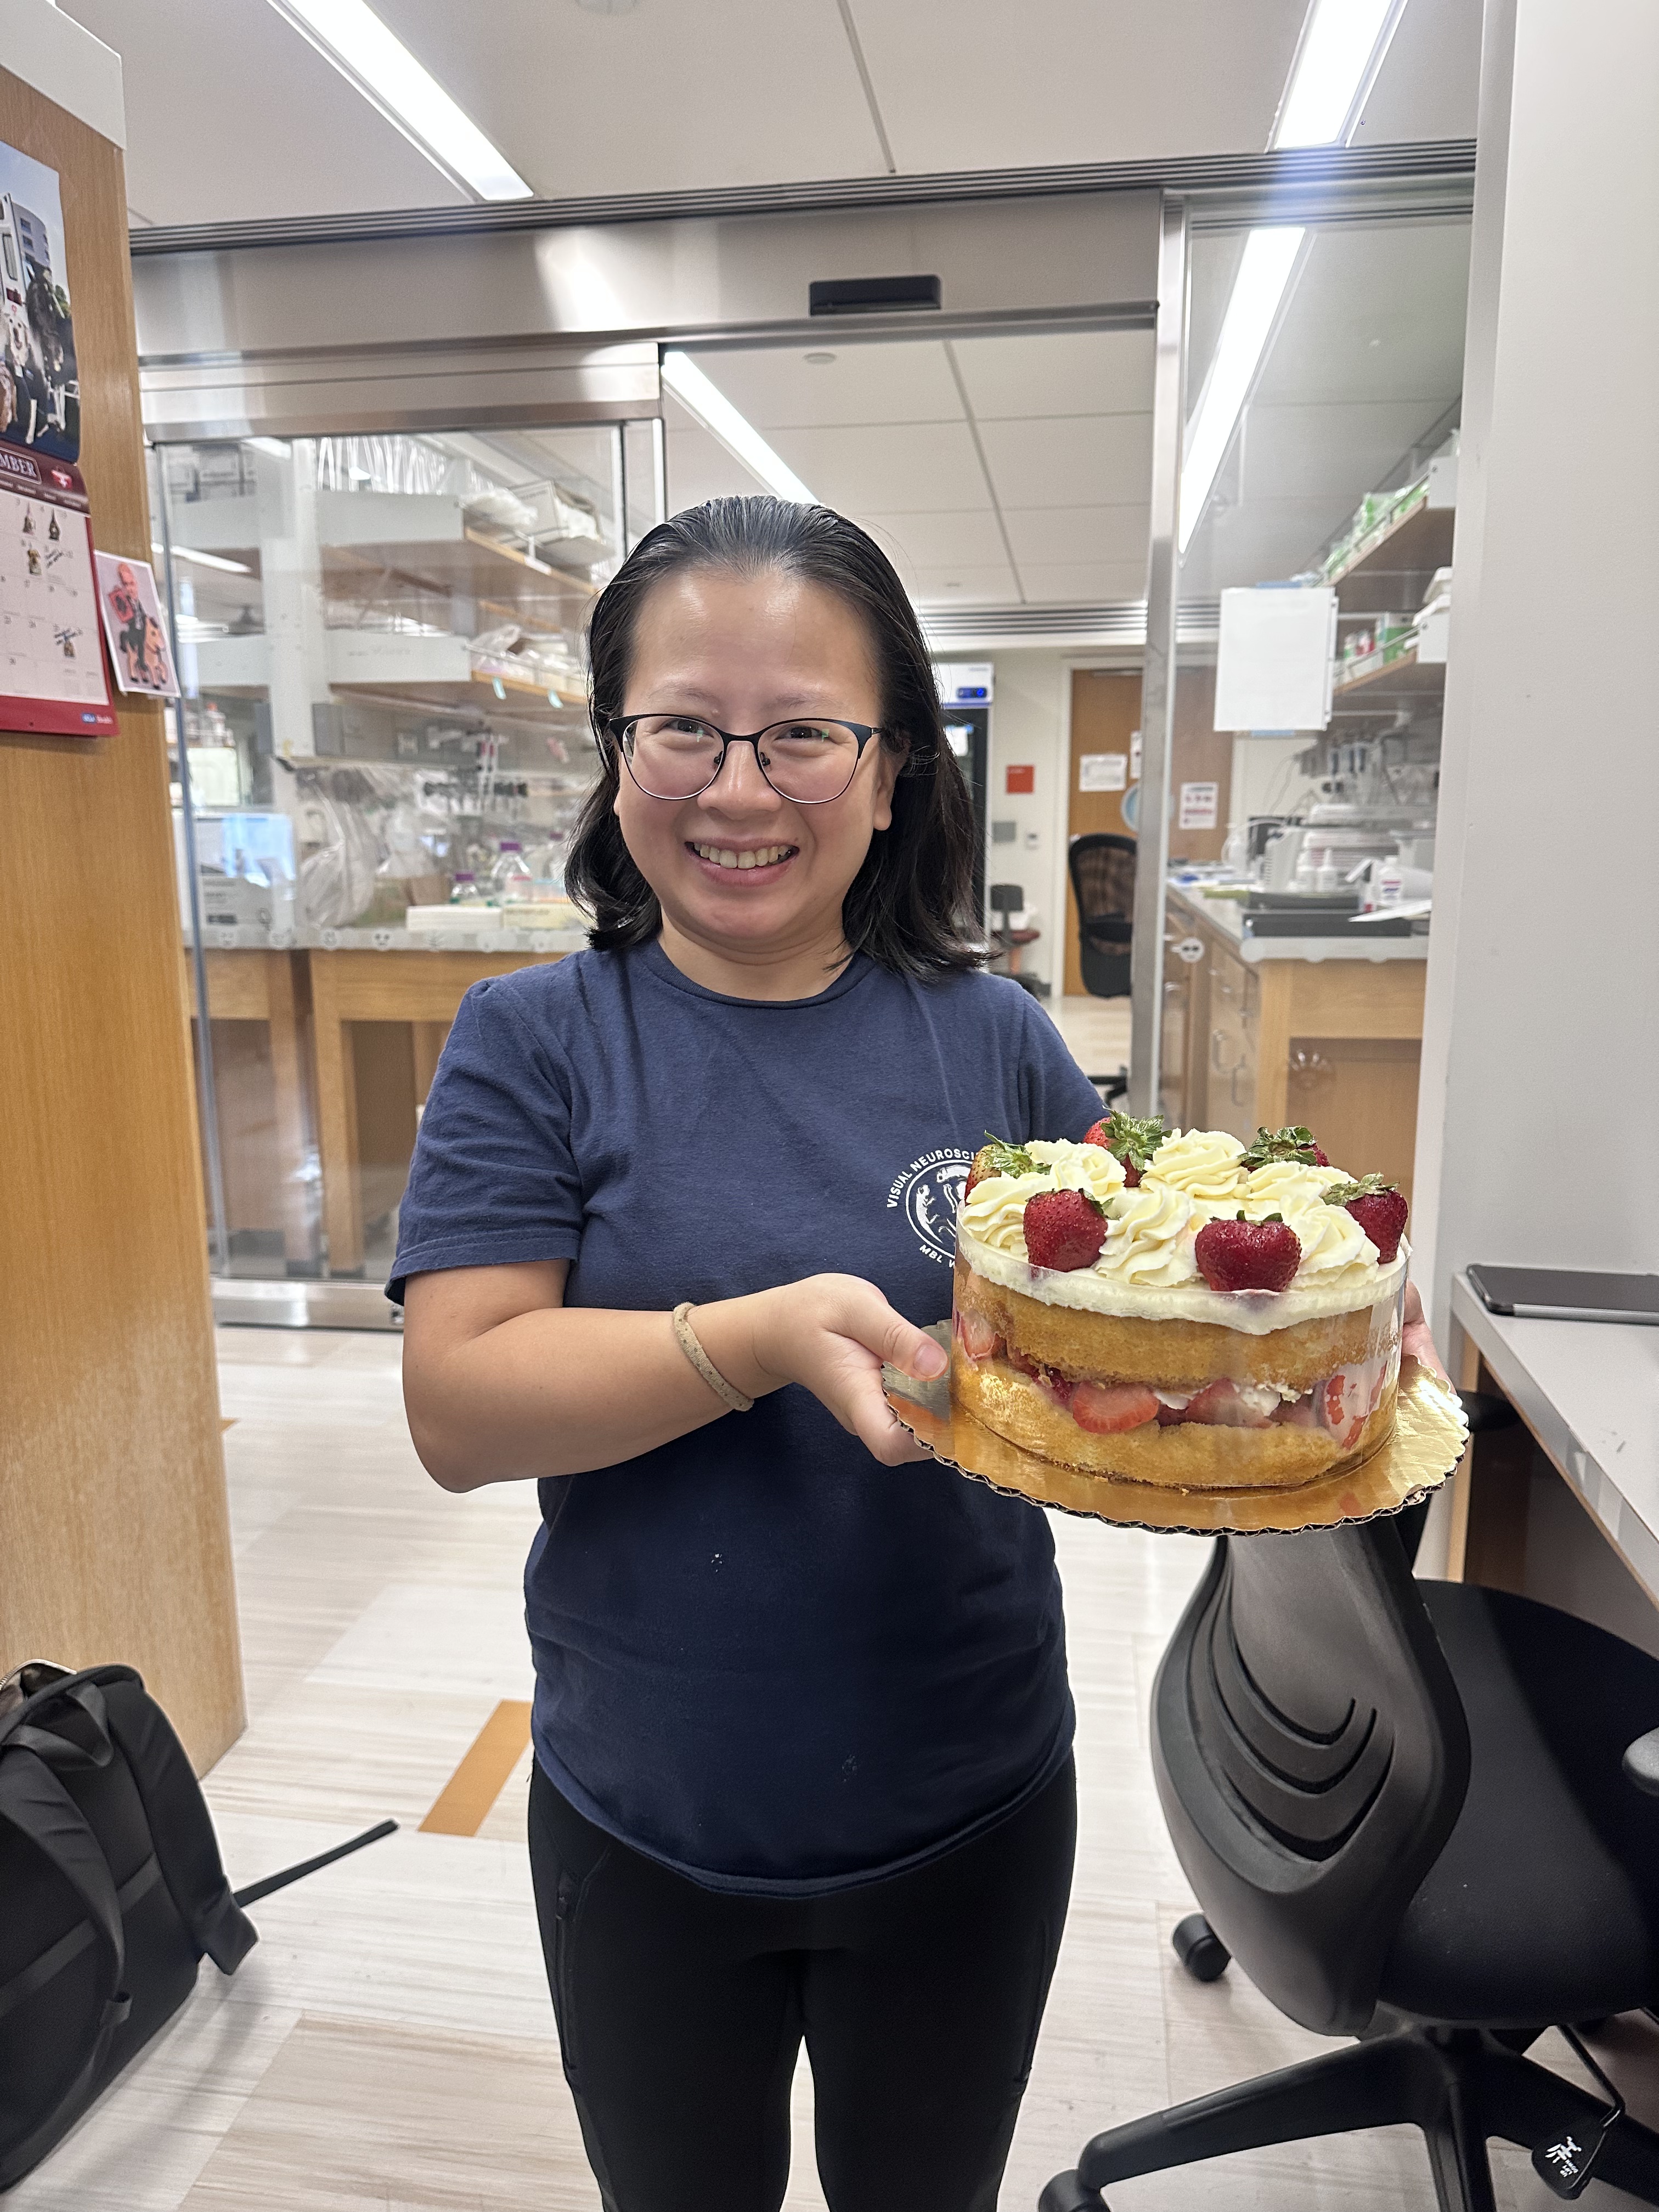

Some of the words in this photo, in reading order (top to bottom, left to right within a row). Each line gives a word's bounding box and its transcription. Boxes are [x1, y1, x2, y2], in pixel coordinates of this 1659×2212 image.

[887, 1171, 913, 1207] VISUAL
[910, 1148, 979, 1172] NEUROSCI
[919, 1244, 943, 1263] MBL
